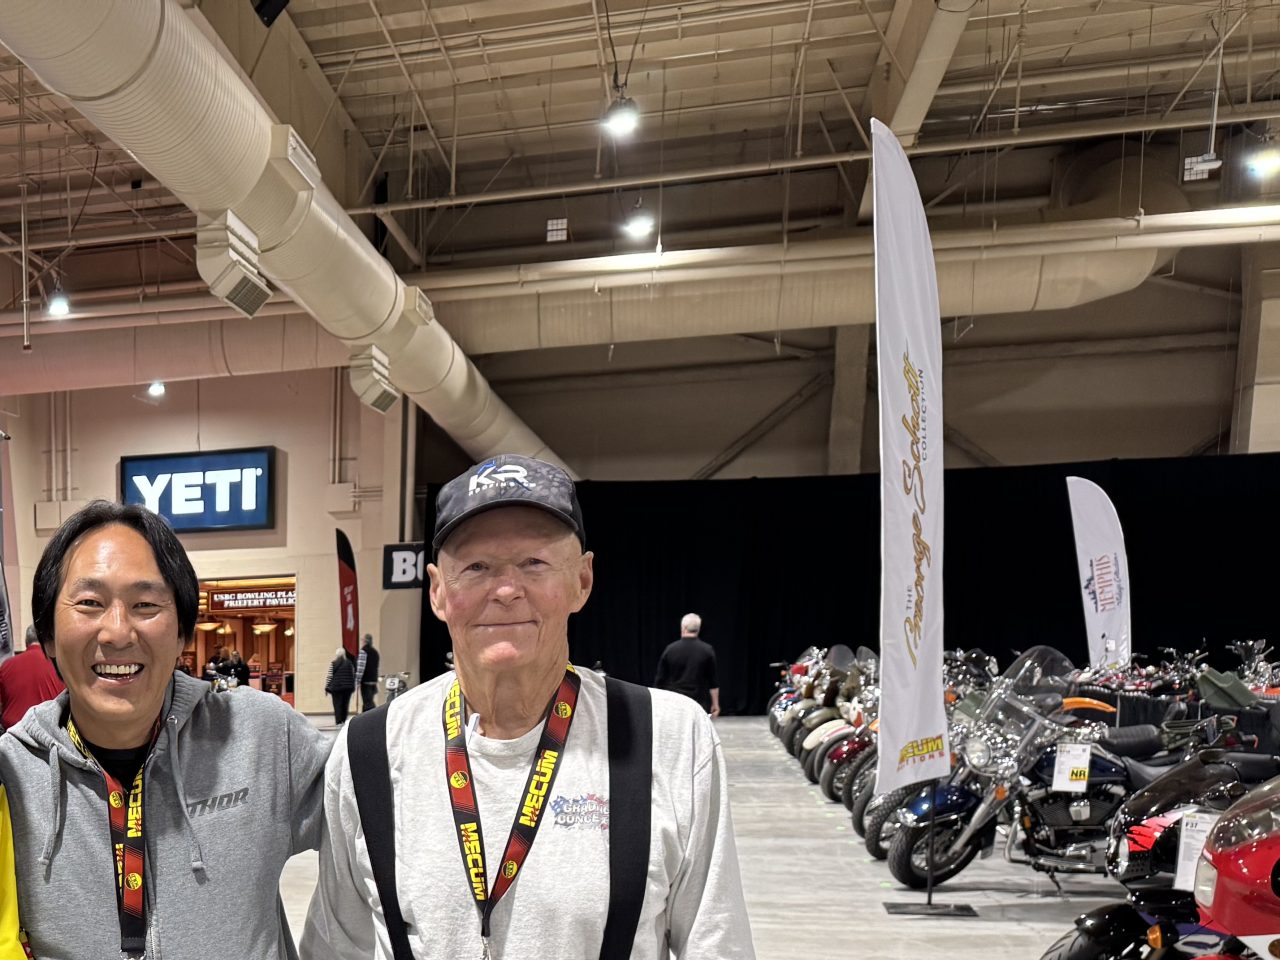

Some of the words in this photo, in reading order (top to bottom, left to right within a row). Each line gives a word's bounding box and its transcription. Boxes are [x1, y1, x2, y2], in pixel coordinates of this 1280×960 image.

[902, 337, 926, 515] Schott
[132, 468, 257, 515] YETI
[236, 591, 276, 600] BOWLING
[265, 598, 296, 606] PAVILIO
[1095, 554, 1116, 612] MEMPHIS
[518, 750, 560, 828] MECUM
[1070, 769, 1086, 777] NR
[186, 787, 250, 819] THOR
[460, 822, 486, 900] MECUM
